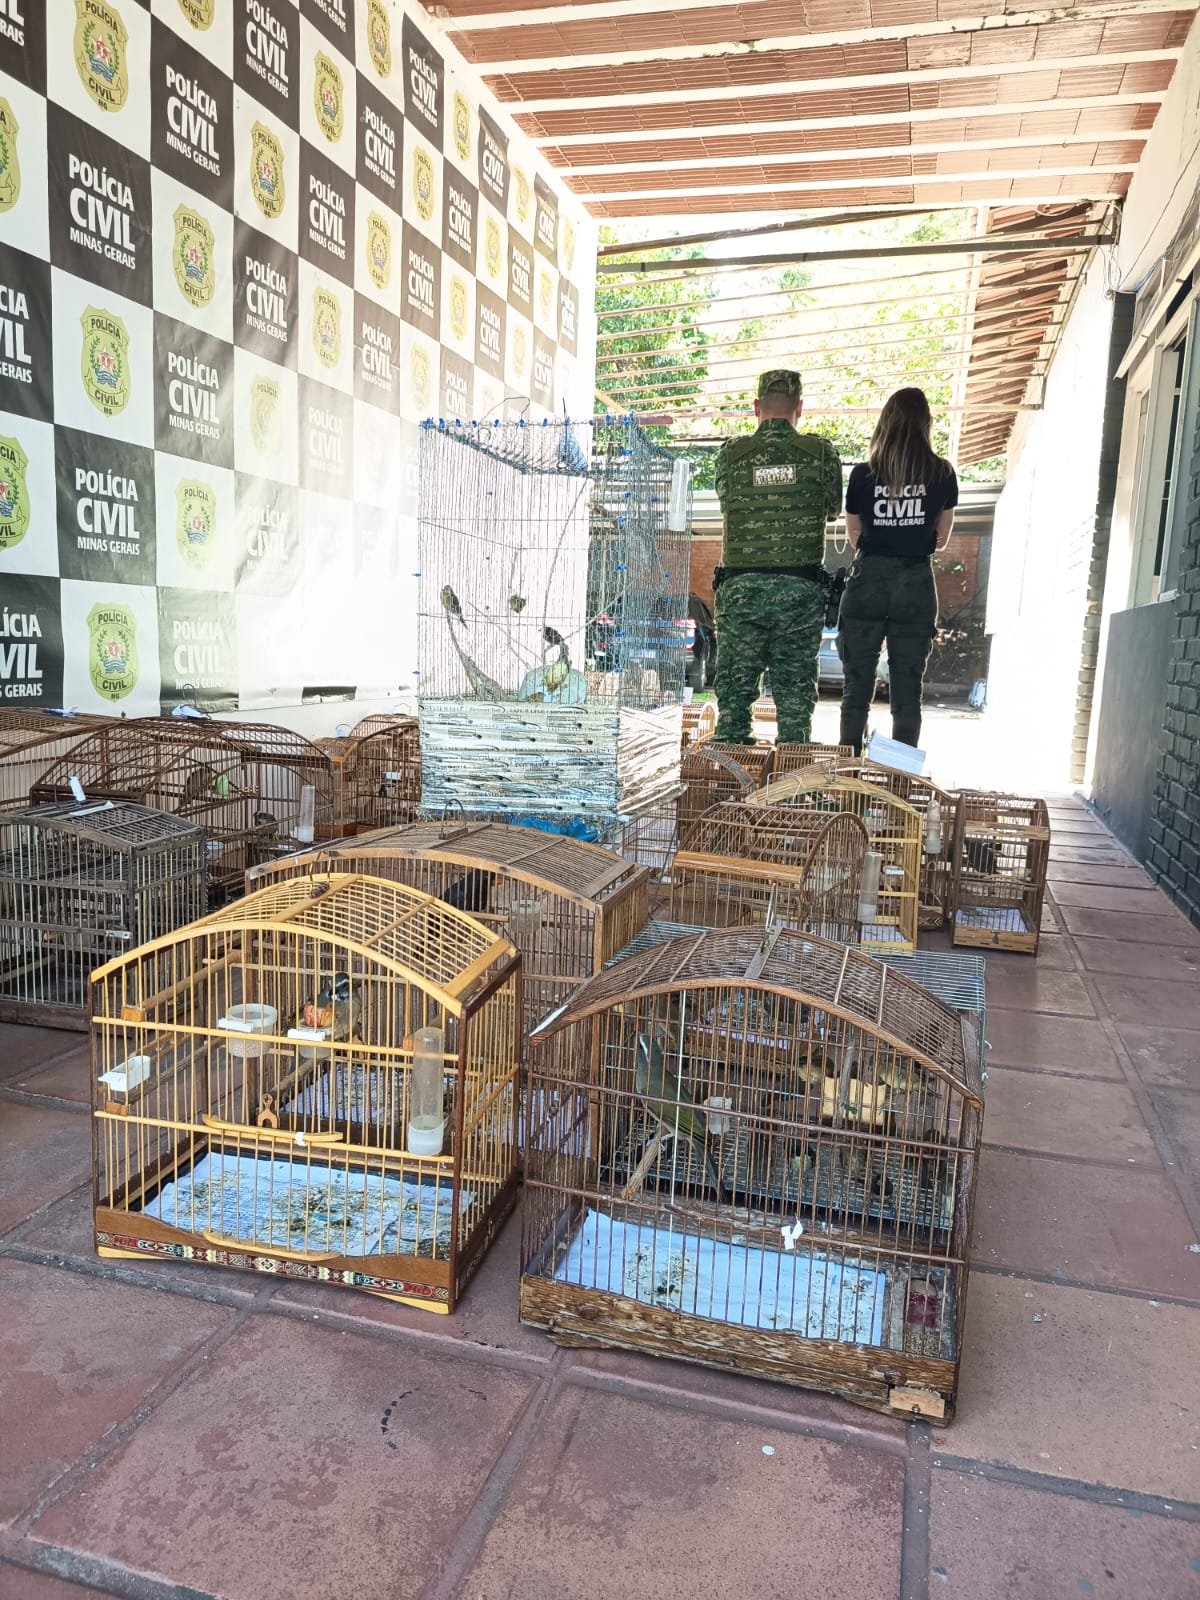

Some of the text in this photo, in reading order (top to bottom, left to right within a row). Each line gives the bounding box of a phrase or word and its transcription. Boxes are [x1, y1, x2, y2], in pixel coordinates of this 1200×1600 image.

[0, 18, 24, 46] RAIS
[85, 1, 118, 34] POLÍCIA
[246, 0, 288, 49] POLÍCIA
[246, 21, 288, 83] CIVIL
[320, 61, 338, 82] POLÍCIA
[409, 47, 438, 90] POLÍCIA
[88, 77, 115, 102] CIVIL
[166, 64, 218, 123] POLÍCIA
[268, 71, 288, 98] GERAIS
[410, 69, 438, 116] CIVIL
[98, 99, 108, 110] MG
[167, 96, 219, 160] CIVIL
[321, 118, 336, 136] CIVIL
[365, 105, 396, 149] POLÍCIA
[167, 131, 220, 176] MINAS GERAIS
[257, 131, 278, 155] POLÍCIA
[365, 129, 396, 177] CIVIL
[69, 153, 135, 212] POLÍCIA
[483, 150, 504, 188] CIVIL
[258, 193, 276, 211] CIVIL
[309, 174, 346, 217] POLÍCIA
[450, 186, 472, 219] POLÍCIA
[69, 187, 135, 252] CIVIL
[182, 215, 208, 238] POLÍCIA
[309, 199, 346, 247] CIVIL
[449, 205, 471, 244] CIVIL
[70, 227, 136, 269] MINAS GERAIS
[309, 228, 346, 260] MINAS GERAIS
[246, 256, 287, 295] POLÍCIA
[408, 249, 434, 282] POLÍCIA
[512, 263, 530, 294] CIVIL
[184, 282, 205, 299] CIVIL
[408, 270, 434, 308] CIVIL
[246, 282, 288, 328] CIVIL
[480, 303, 501, 331] POLÍCIA
[91, 318, 121, 340] POLÍCIA
[246, 313, 288, 342] MINAS GERAIS
[362, 322, 392, 353] POLÍCIA
[480, 321, 500, 352] CIVIL
[168, 351, 219, 389] POLÍCIA
[362, 343, 392, 381] CIVIL
[446, 369, 467, 394] POLÍCIA
[94, 389, 119, 406] CIVIL
[103, 406, 113, 415] MG
[168, 380, 220, 424] CIVIL
[169, 413, 220, 440] MINAS GERAIS
[308, 406, 343, 436] POLÍCIA
[309, 429, 344, 464] CIVIL
[76, 468, 138, 501] POLÍCIA
[184, 487, 209, 502] POLÍCIA
[76, 498, 140, 539] CIVIL
[873, 499, 925, 518] CIVIL
[873, 518, 925, 526] MINAS GERAIS
[77, 536, 140, 555] MINAS GERAIS
[0, 607, 42, 638] ÍCIA
[98, 613, 128, 626] POLÍCIA
[172, 619, 223, 641] POLÍCIA
[0, 643, 43, 679] VIL
[174, 644, 224, 674] CIVIL
[5, 683, 43, 698] GERAIS
[102, 678, 127, 690] CIVIL
[111, 692, 120, 700] MG
[175, 678, 200, 690] MINAS
